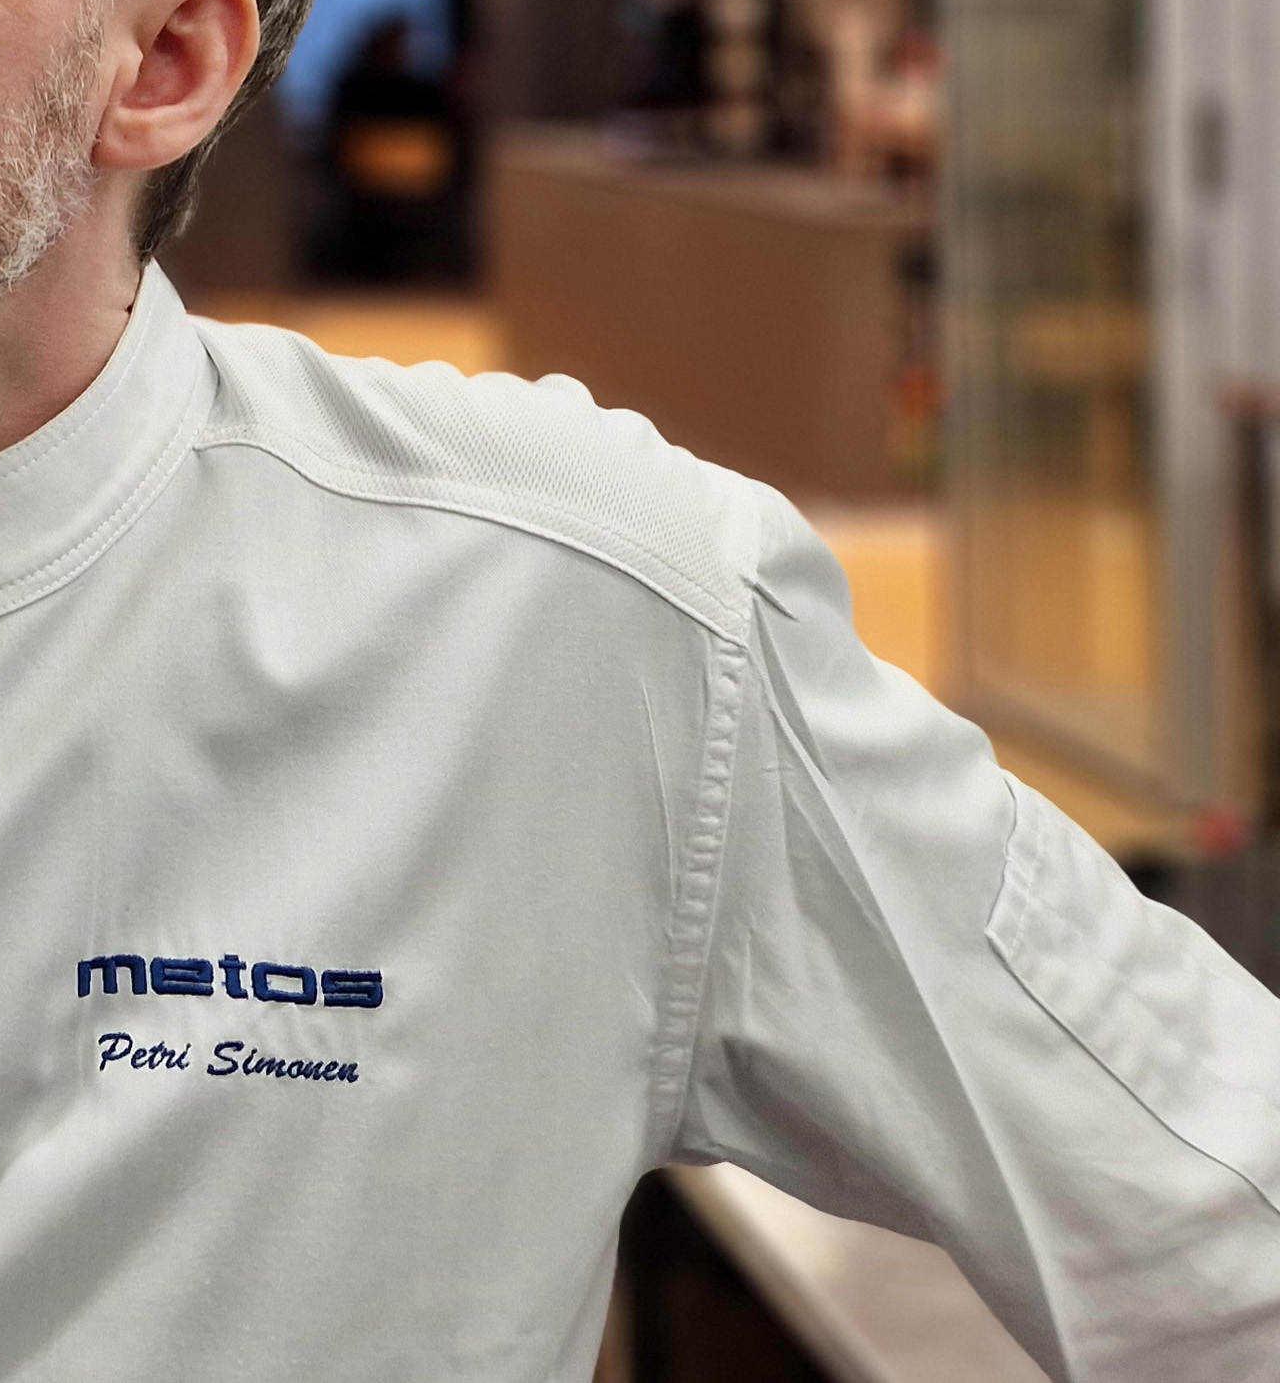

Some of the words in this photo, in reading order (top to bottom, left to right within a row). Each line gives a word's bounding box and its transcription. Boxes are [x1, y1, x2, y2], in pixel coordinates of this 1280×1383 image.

[77, 954, 384, 1009] metos
[97, 1031, 192, 1072] Petri
[205, 1039, 360, 1084] Simonen
